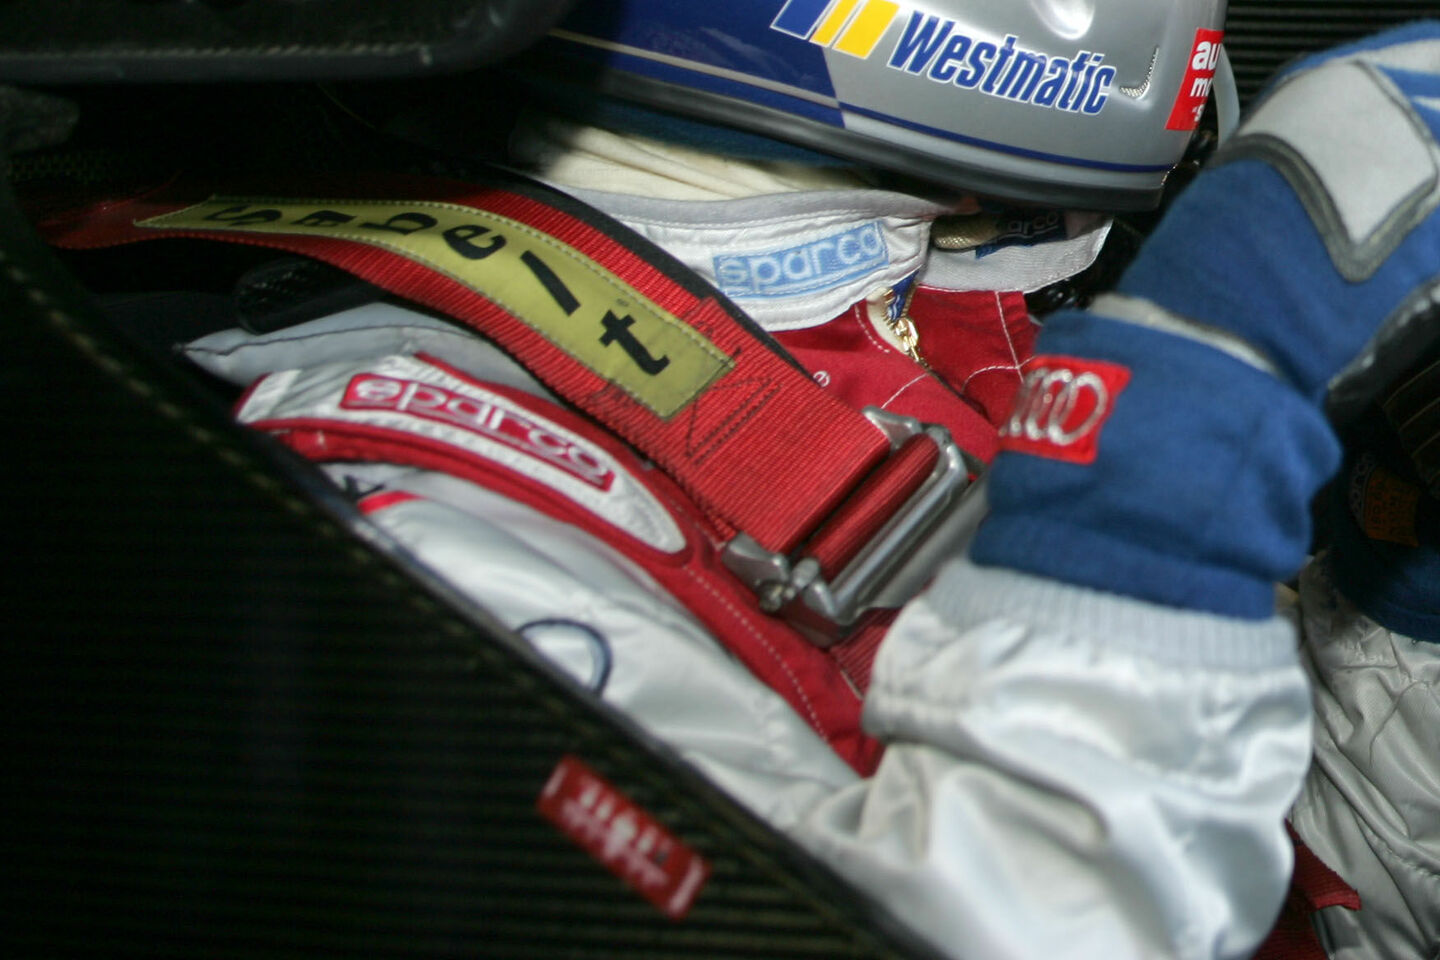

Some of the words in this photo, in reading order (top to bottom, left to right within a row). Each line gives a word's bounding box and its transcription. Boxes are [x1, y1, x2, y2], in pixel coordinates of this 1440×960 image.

[888, 8, 1117, 116] Westmatic
[719, 226, 882, 290] sparco
[1004, 211, 1059, 237] arco
[354, 378, 609, 478] sparco
